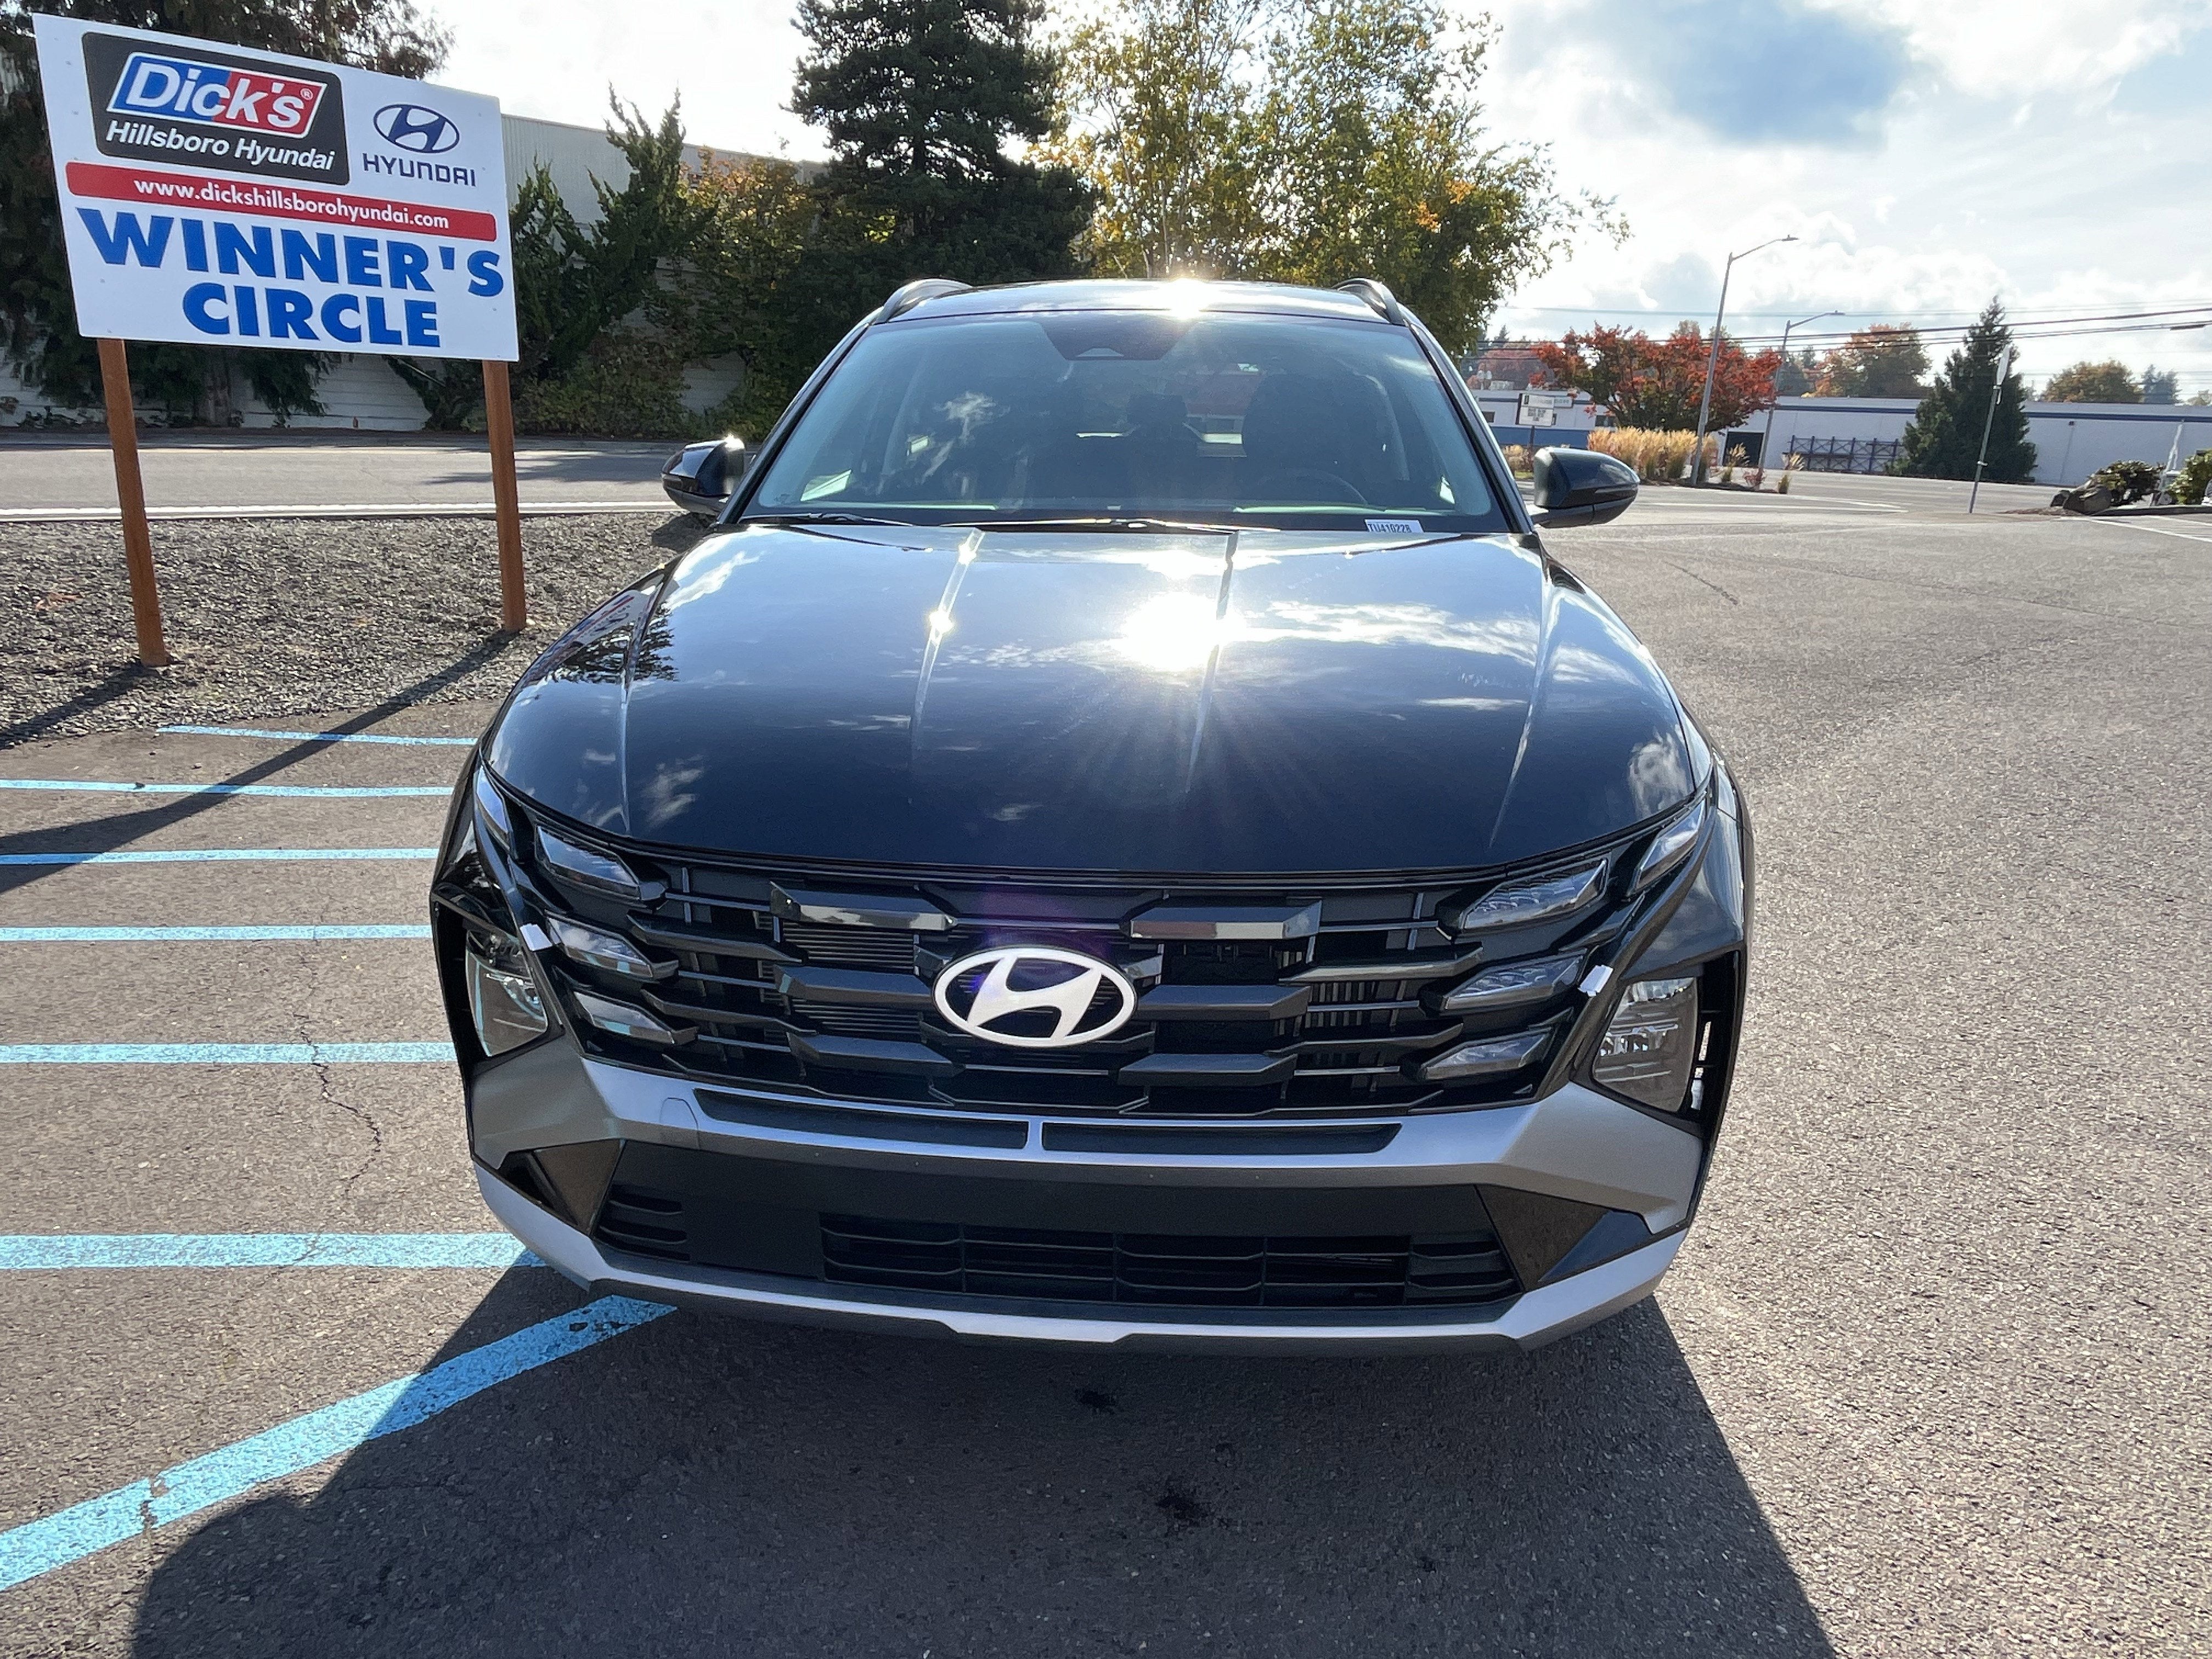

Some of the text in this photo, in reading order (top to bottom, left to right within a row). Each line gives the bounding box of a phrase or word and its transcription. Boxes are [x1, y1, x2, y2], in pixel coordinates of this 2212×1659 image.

[126, 62, 305, 128] Dick's
[106, 120, 335, 171] Hillsboro Hyundai
[362, 153, 476, 187] HYUNDAI
[133, 178, 449, 229] www.dickshillsborohyundai.com
[76, 207, 504, 297] WINNER'S
[182, 282, 441, 348] CIRCLE
